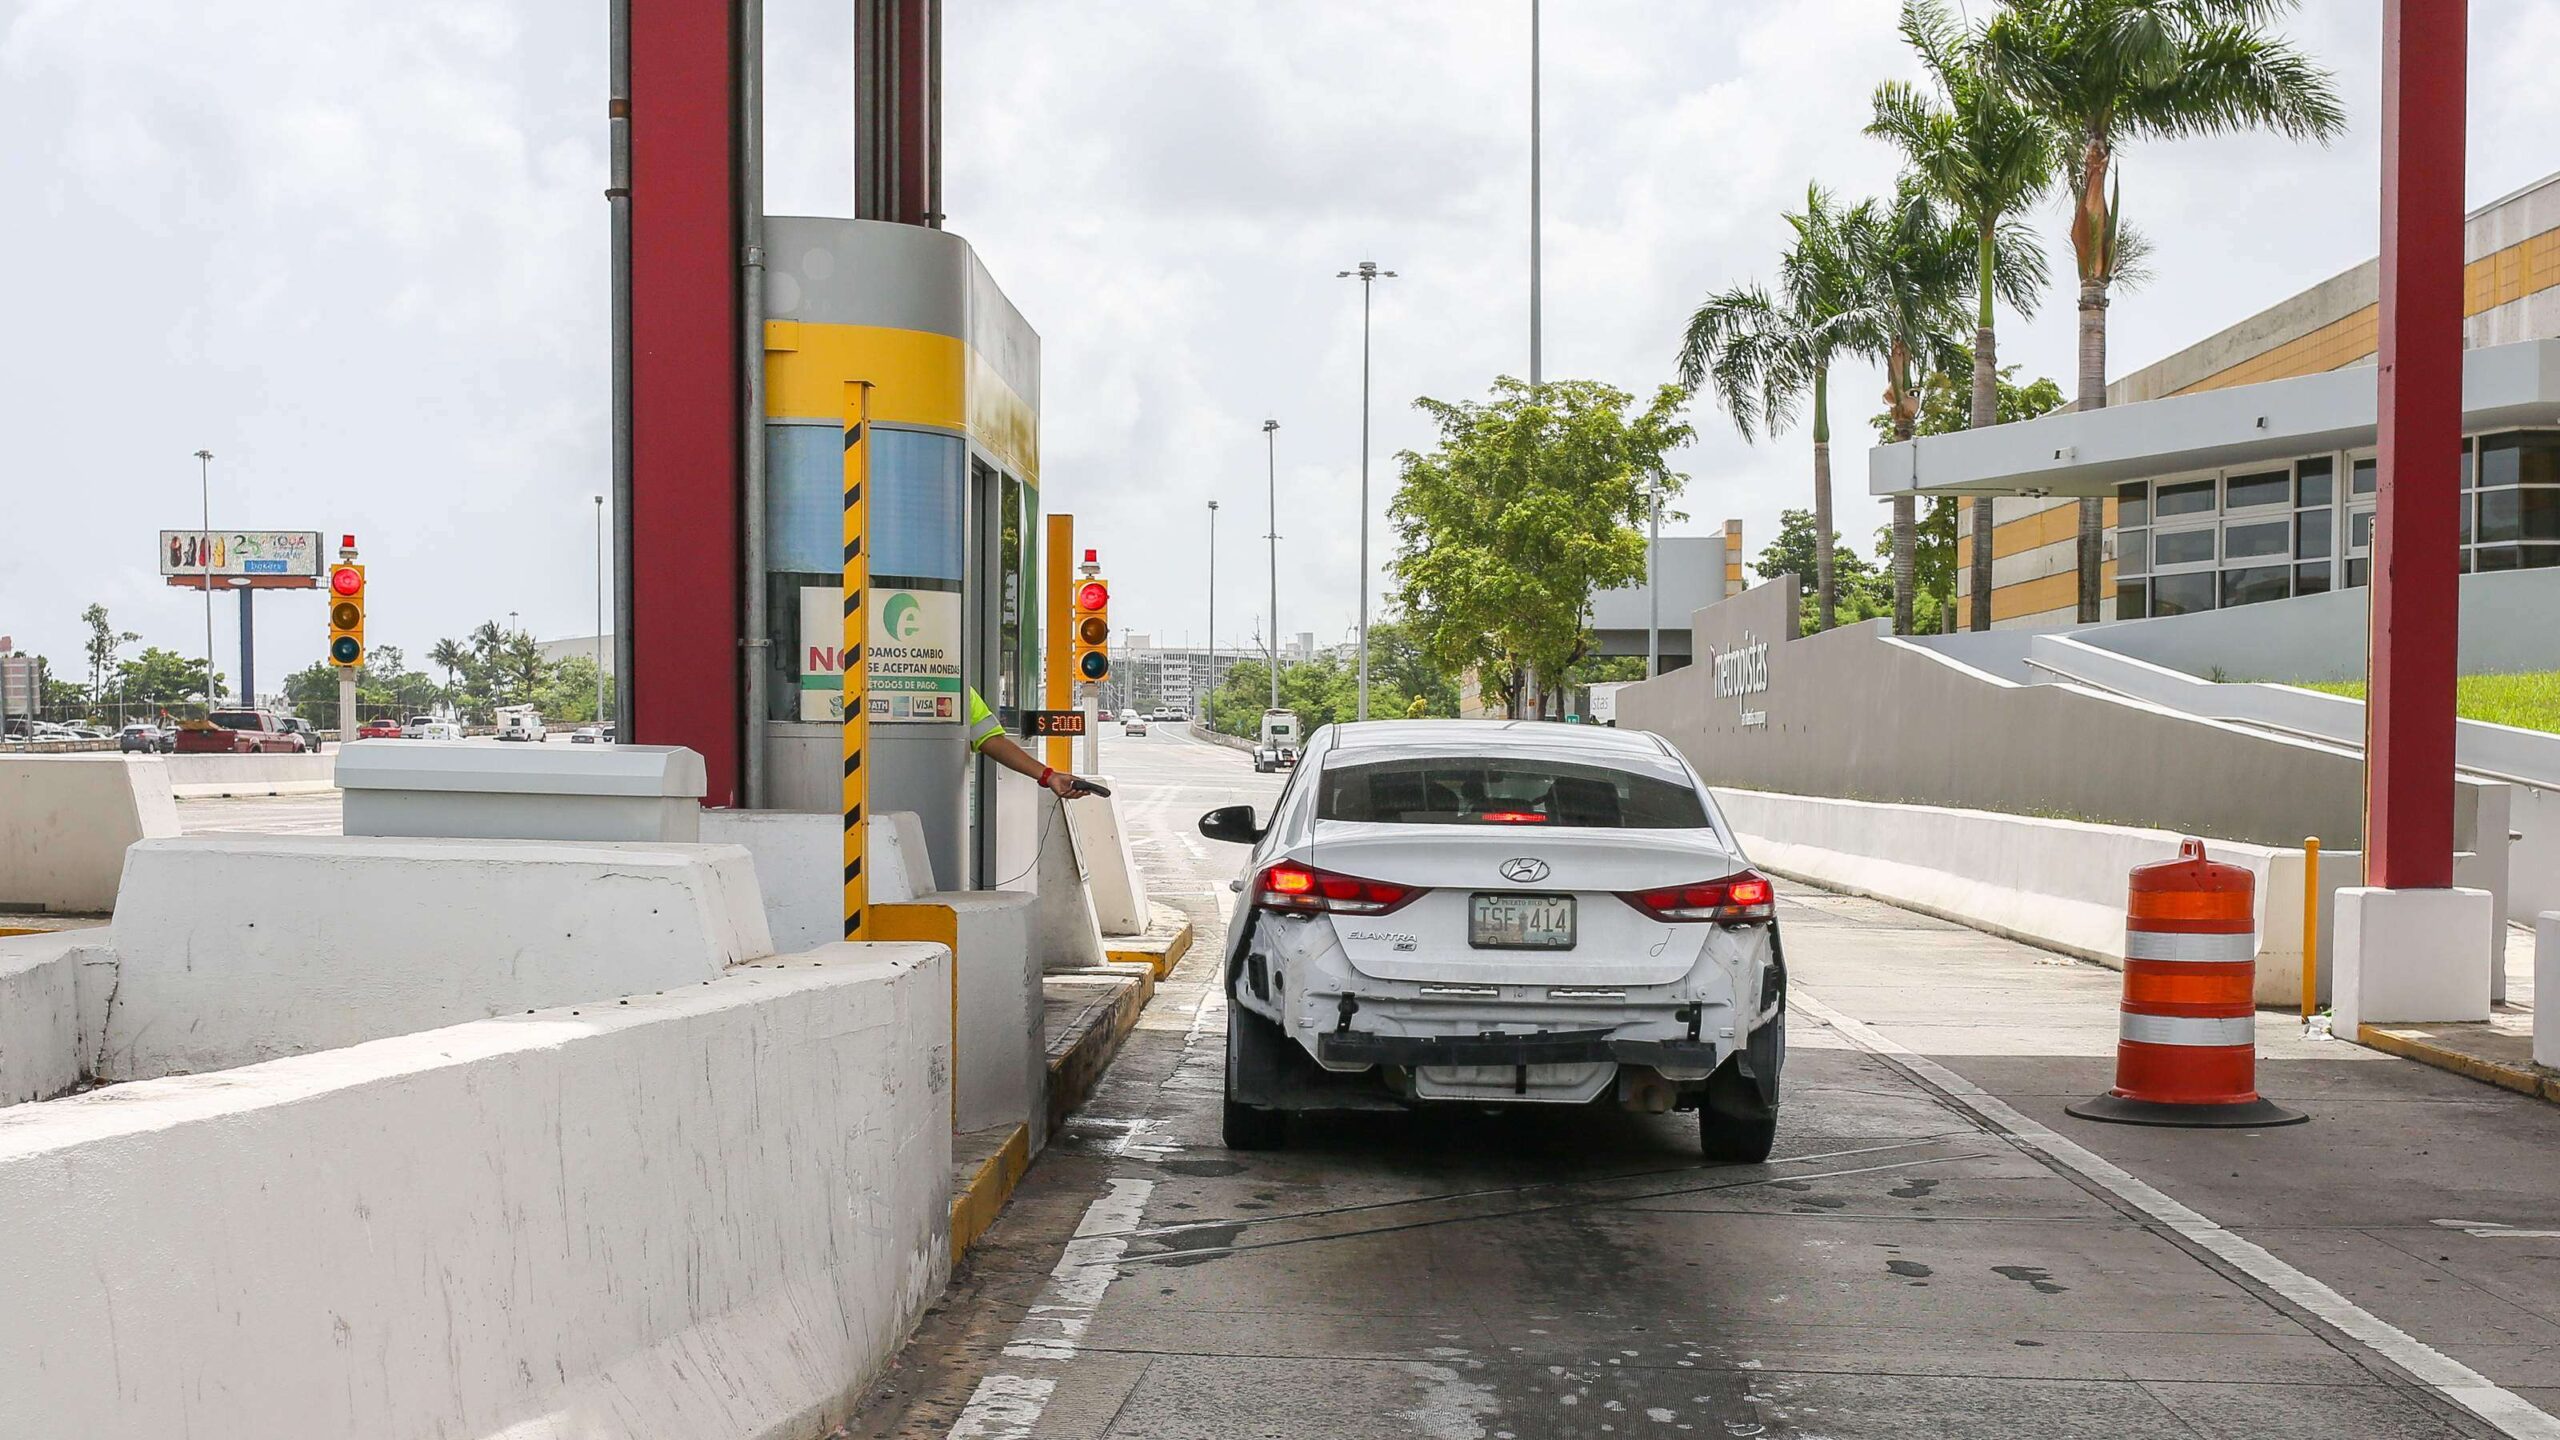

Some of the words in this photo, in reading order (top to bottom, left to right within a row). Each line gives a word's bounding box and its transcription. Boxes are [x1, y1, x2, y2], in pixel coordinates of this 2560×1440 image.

[910, 648, 944, 660] CAMBIO
[883, 662, 927, 674] ACEPTAN
[929, 663, 960, 675] MONEDAS
[1714, 629, 1768, 715] metropistas
[905, 680, 915, 689] DE
[917, 681, 938, 690] PAGO:
[871, 700, 888, 710] ATH
[915, 699, 933, 710] VISA
[1038, 715, 1046, 732] $
[1530, 907, 1567, 933] 414
[1347, 930, 1417, 943] ELANTRA
